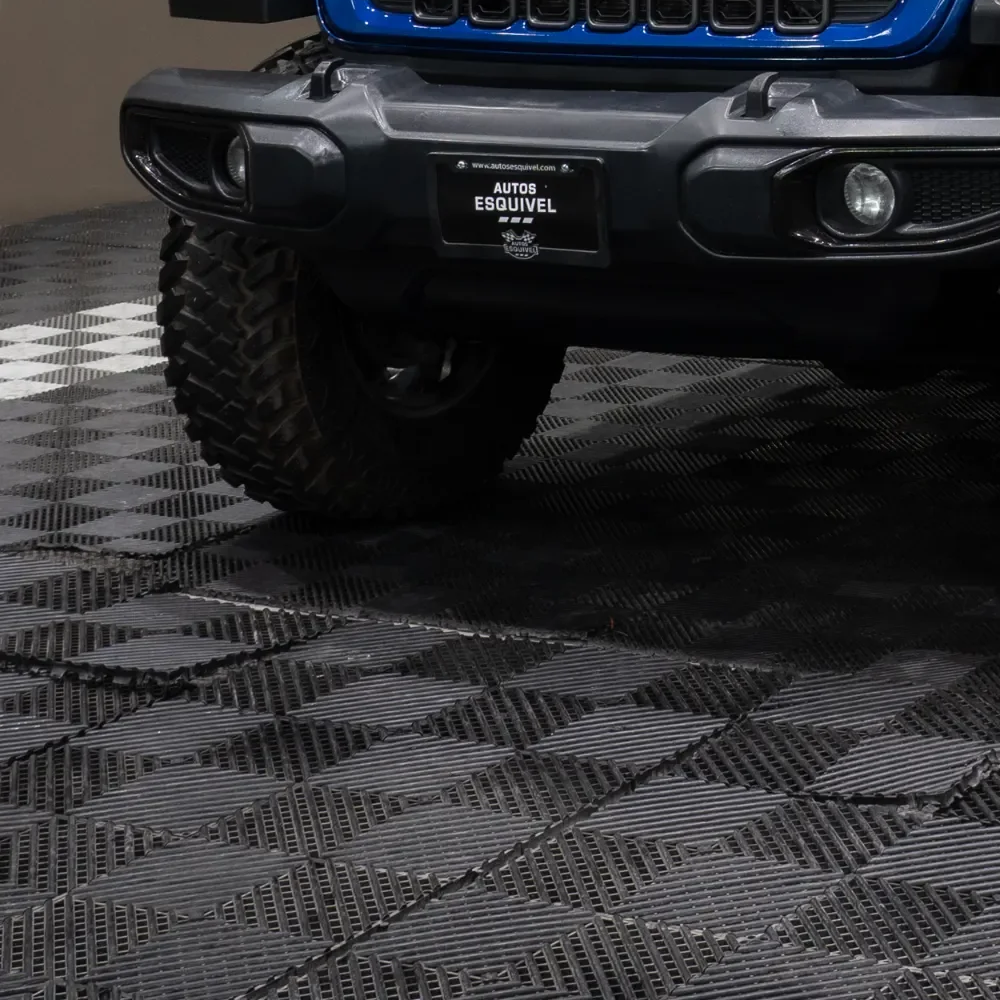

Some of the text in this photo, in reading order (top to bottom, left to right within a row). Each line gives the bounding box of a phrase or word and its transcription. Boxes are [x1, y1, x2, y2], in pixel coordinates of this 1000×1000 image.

[472, 162, 556, 172] www.autosesquivel.com
[493, 182, 537, 195] AUTOS
[474, 196, 557, 213] ESQUIVEL
